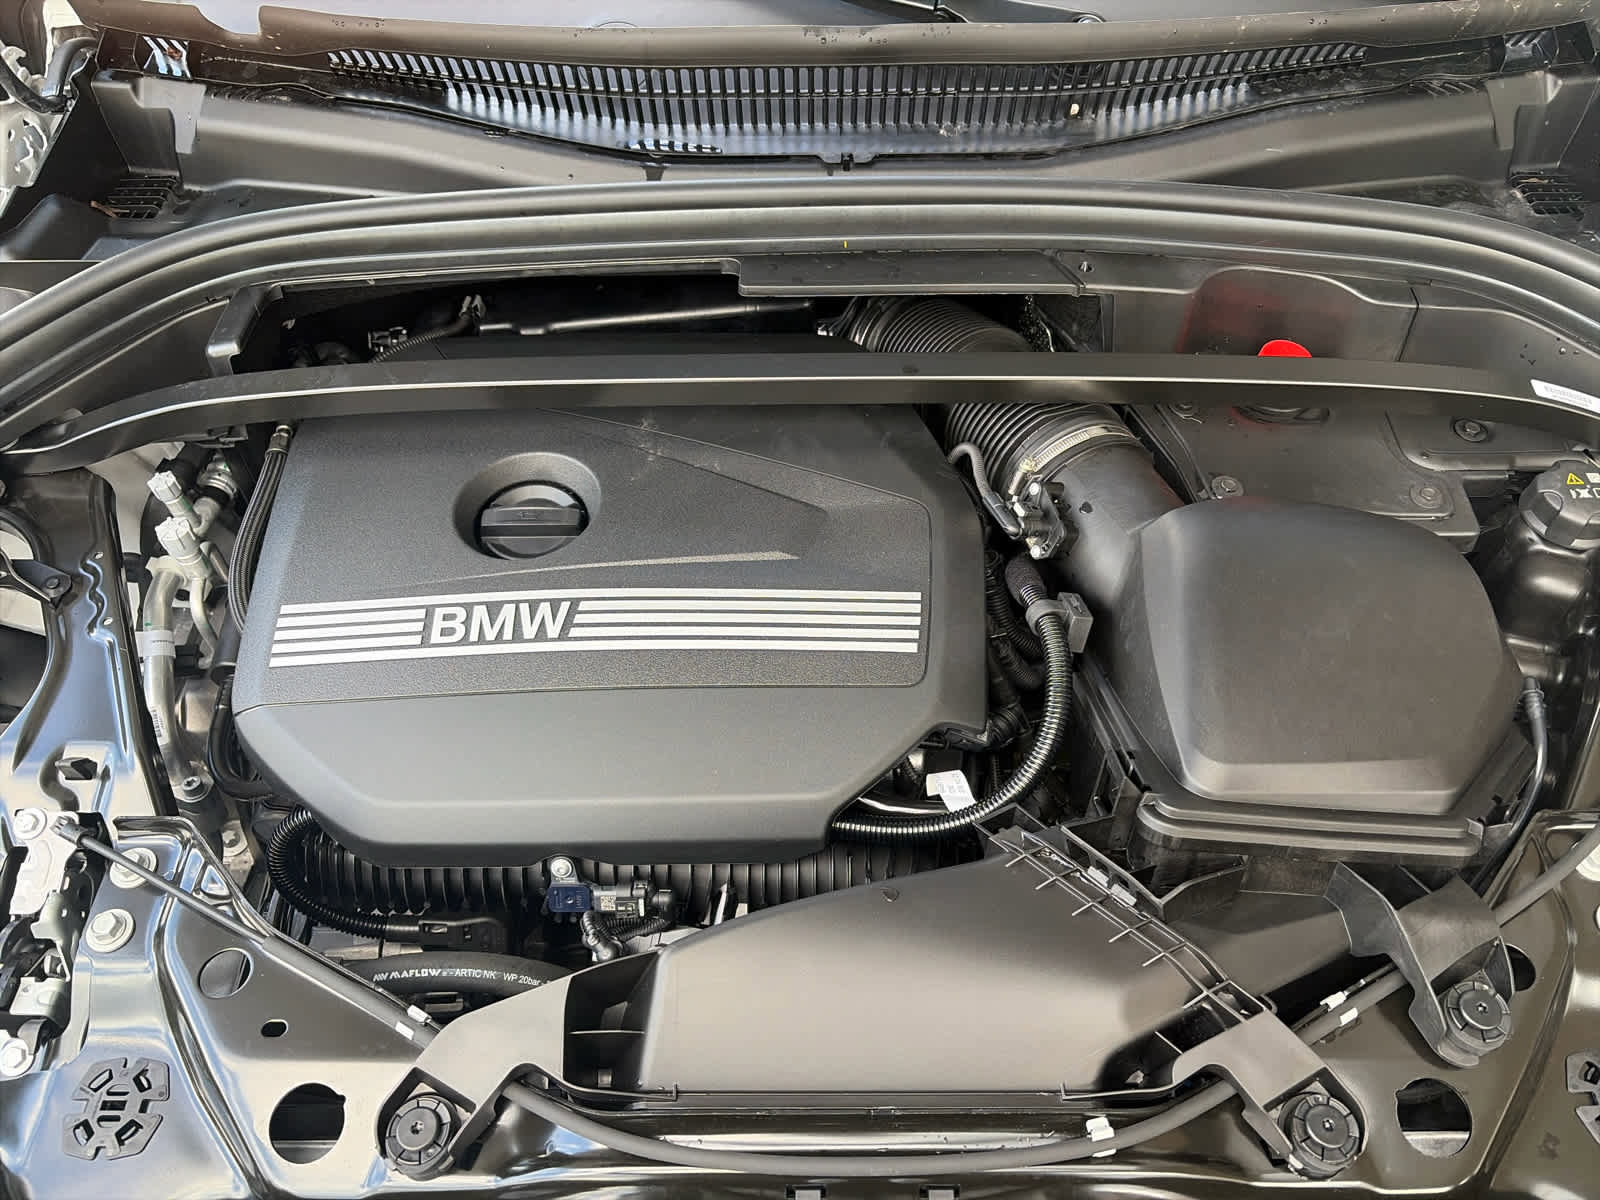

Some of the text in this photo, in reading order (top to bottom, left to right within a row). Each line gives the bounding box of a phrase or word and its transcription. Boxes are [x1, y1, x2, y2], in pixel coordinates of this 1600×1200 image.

[430, 601, 571, 644] BMW
[389, 968, 442, 980] MAFLOW
[518, 975, 541, 987] 20bar
